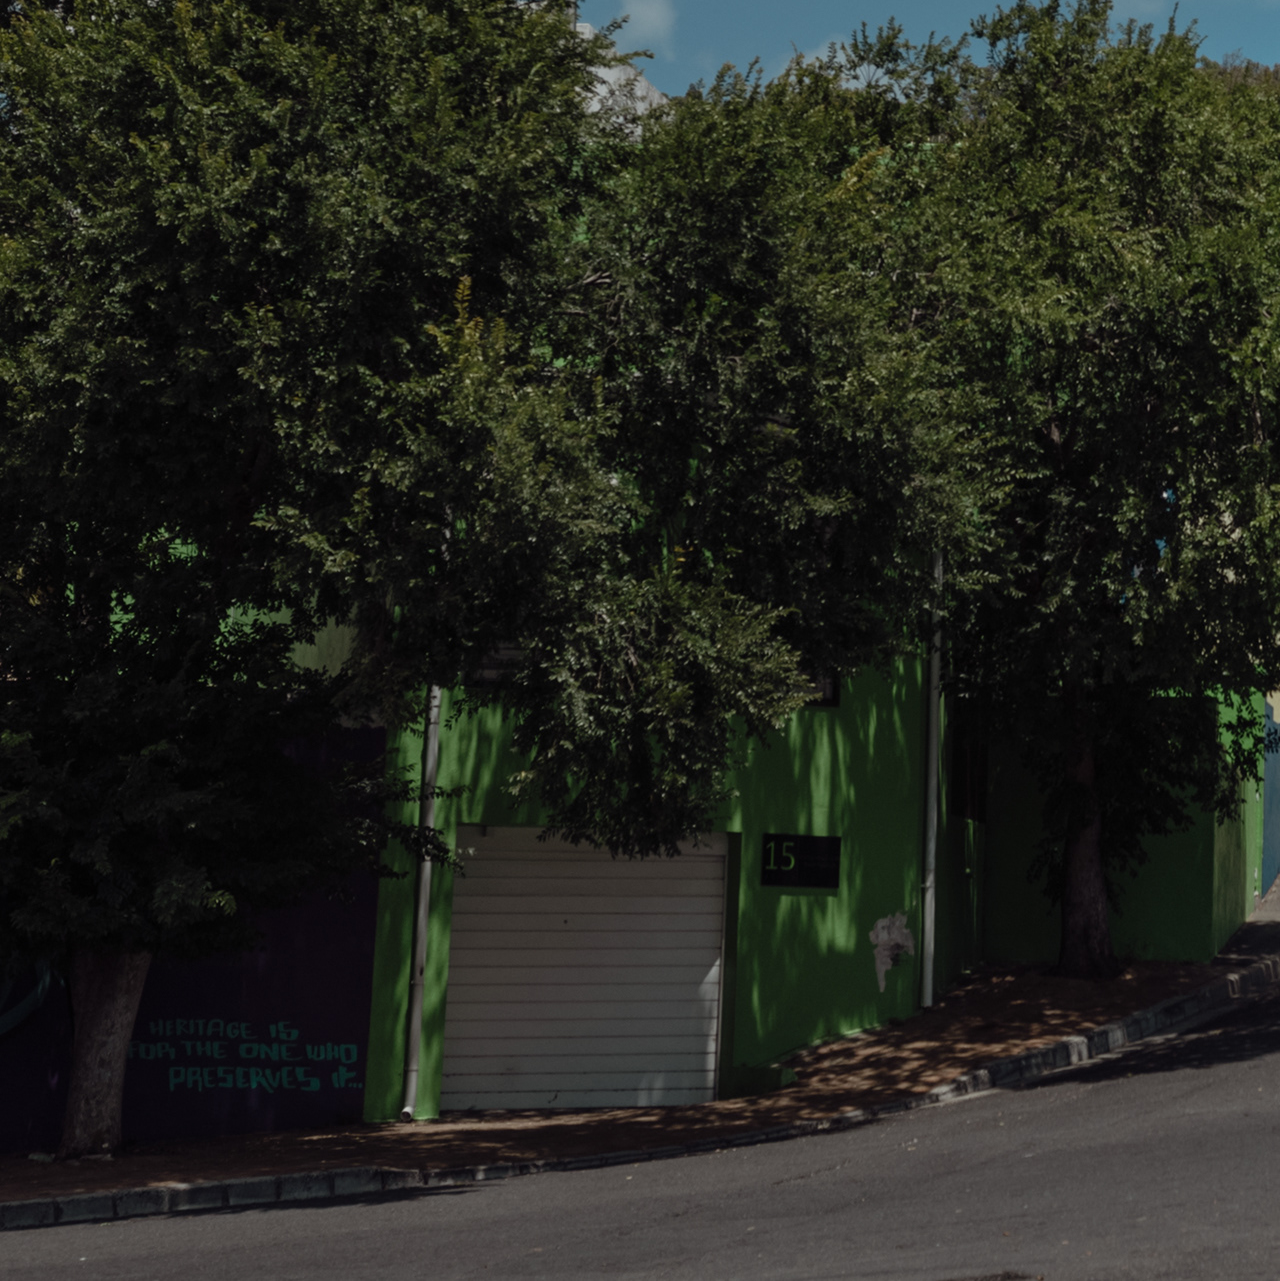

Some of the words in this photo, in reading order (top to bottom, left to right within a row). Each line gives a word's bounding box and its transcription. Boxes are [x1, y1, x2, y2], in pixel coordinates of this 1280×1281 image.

[765, 840, 796, 871] 15
[149, 1019, 258, 1039] HERITAGE
[269, 1021, 299, 1041] IS
[128, 1040, 176, 1060] FOR
[181, 1040, 228, 1059] THE
[239, 1042, 304, 1062] ONE
[305, 1042, 358, 1064] WHO
[168, 1065, 321, 1094] PRESERVES
